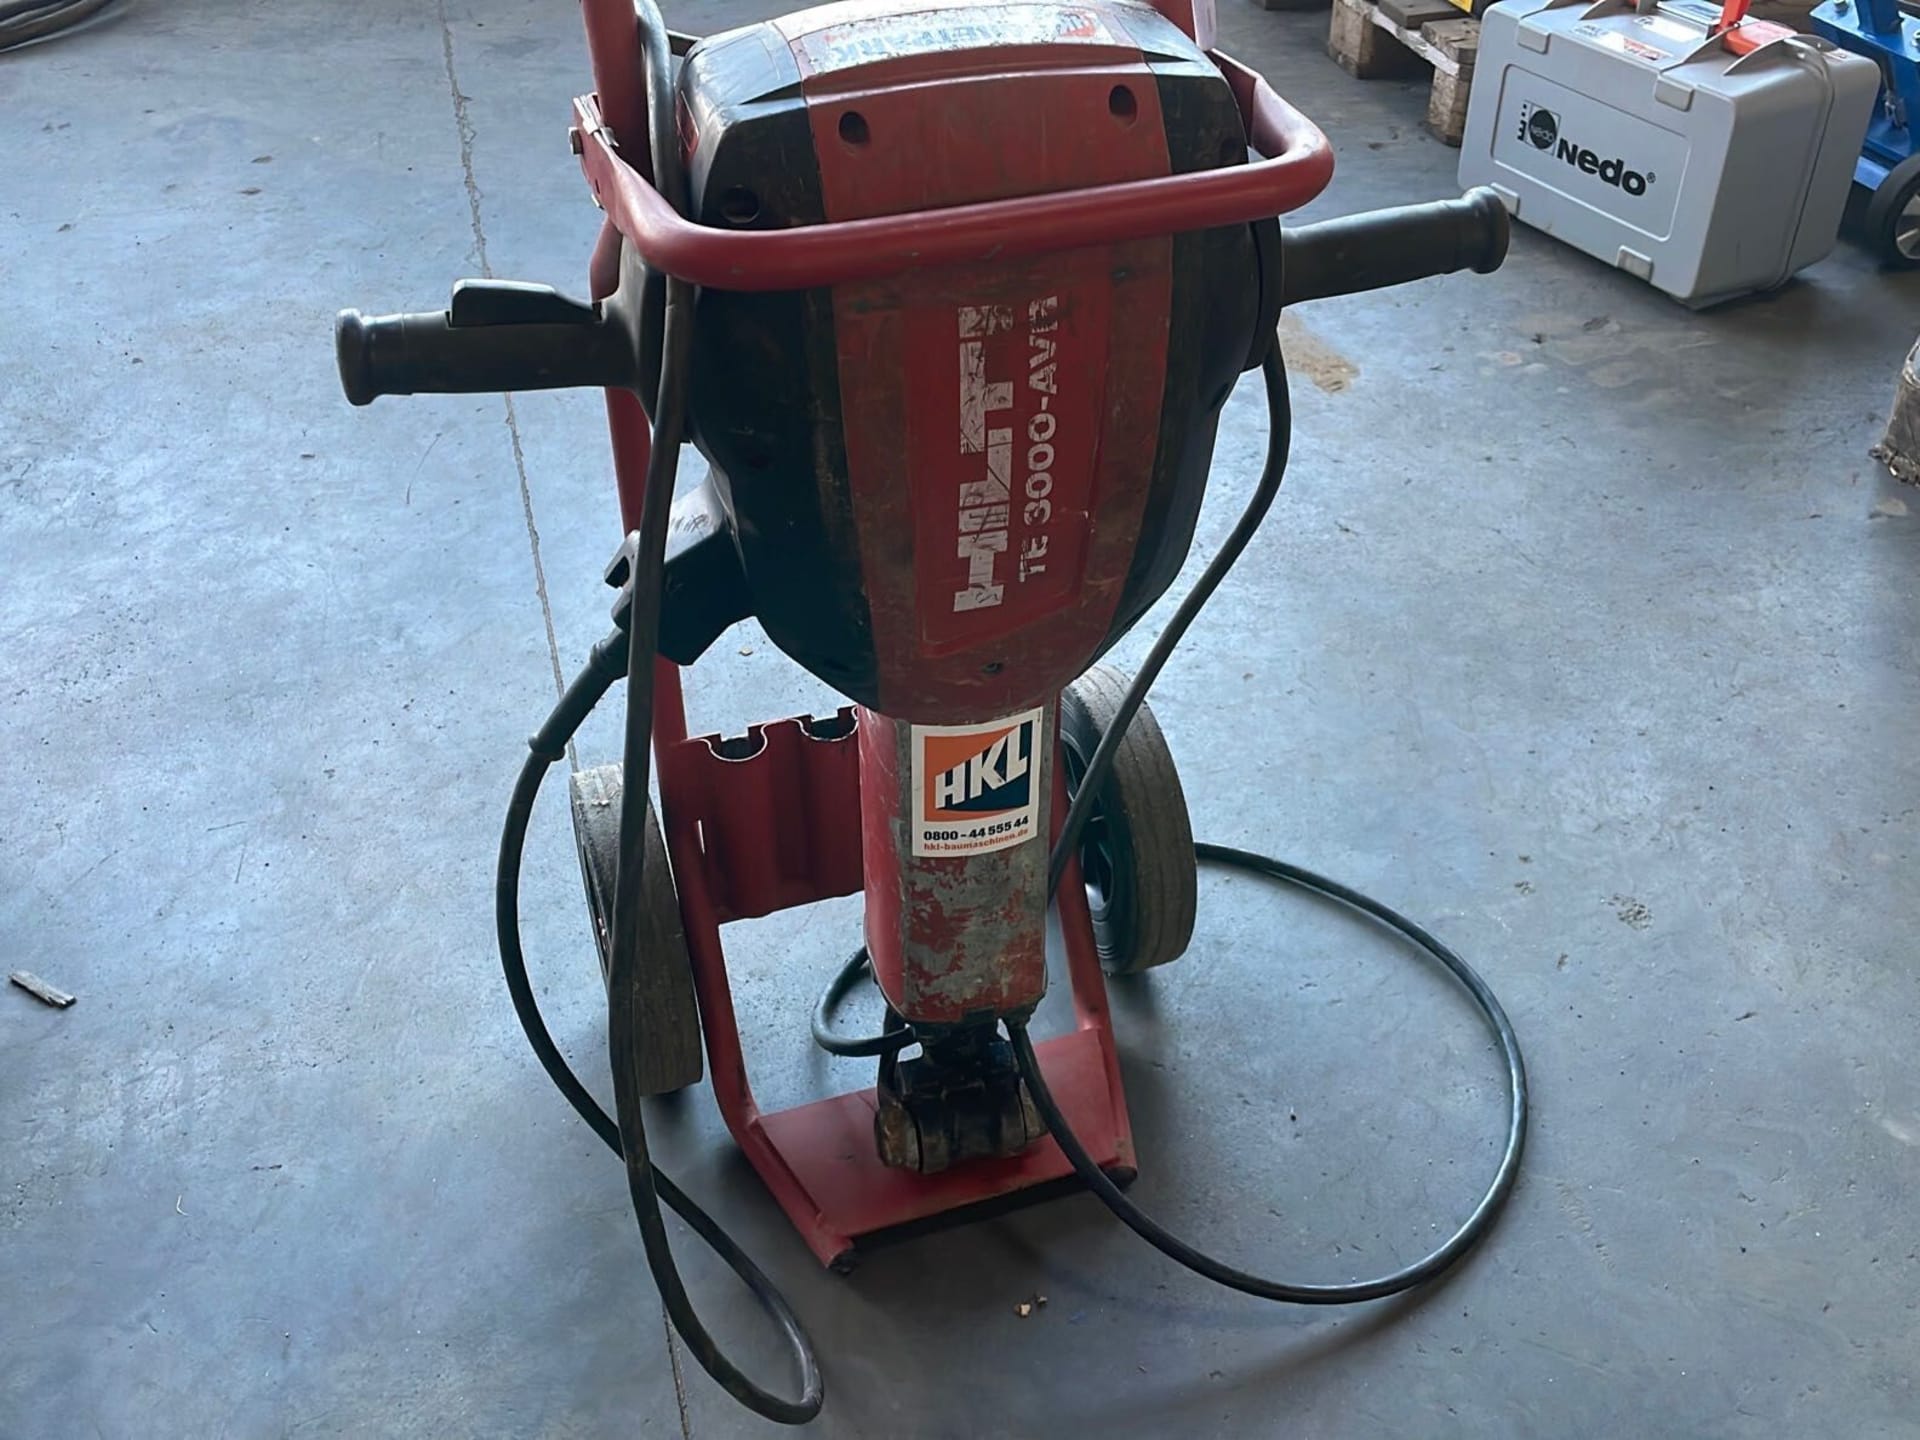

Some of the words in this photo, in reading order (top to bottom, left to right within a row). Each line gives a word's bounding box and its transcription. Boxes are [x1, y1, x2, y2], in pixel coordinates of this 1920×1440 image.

[953, 306, 1013, 612] HILTI
[1018, 535, 1049, 583] TE
[935, 724, 1027, 809] HKL
[923, 829, 1028, 850] hkl-baumaschinen.de
[924, 831, 958, 840] 0800
